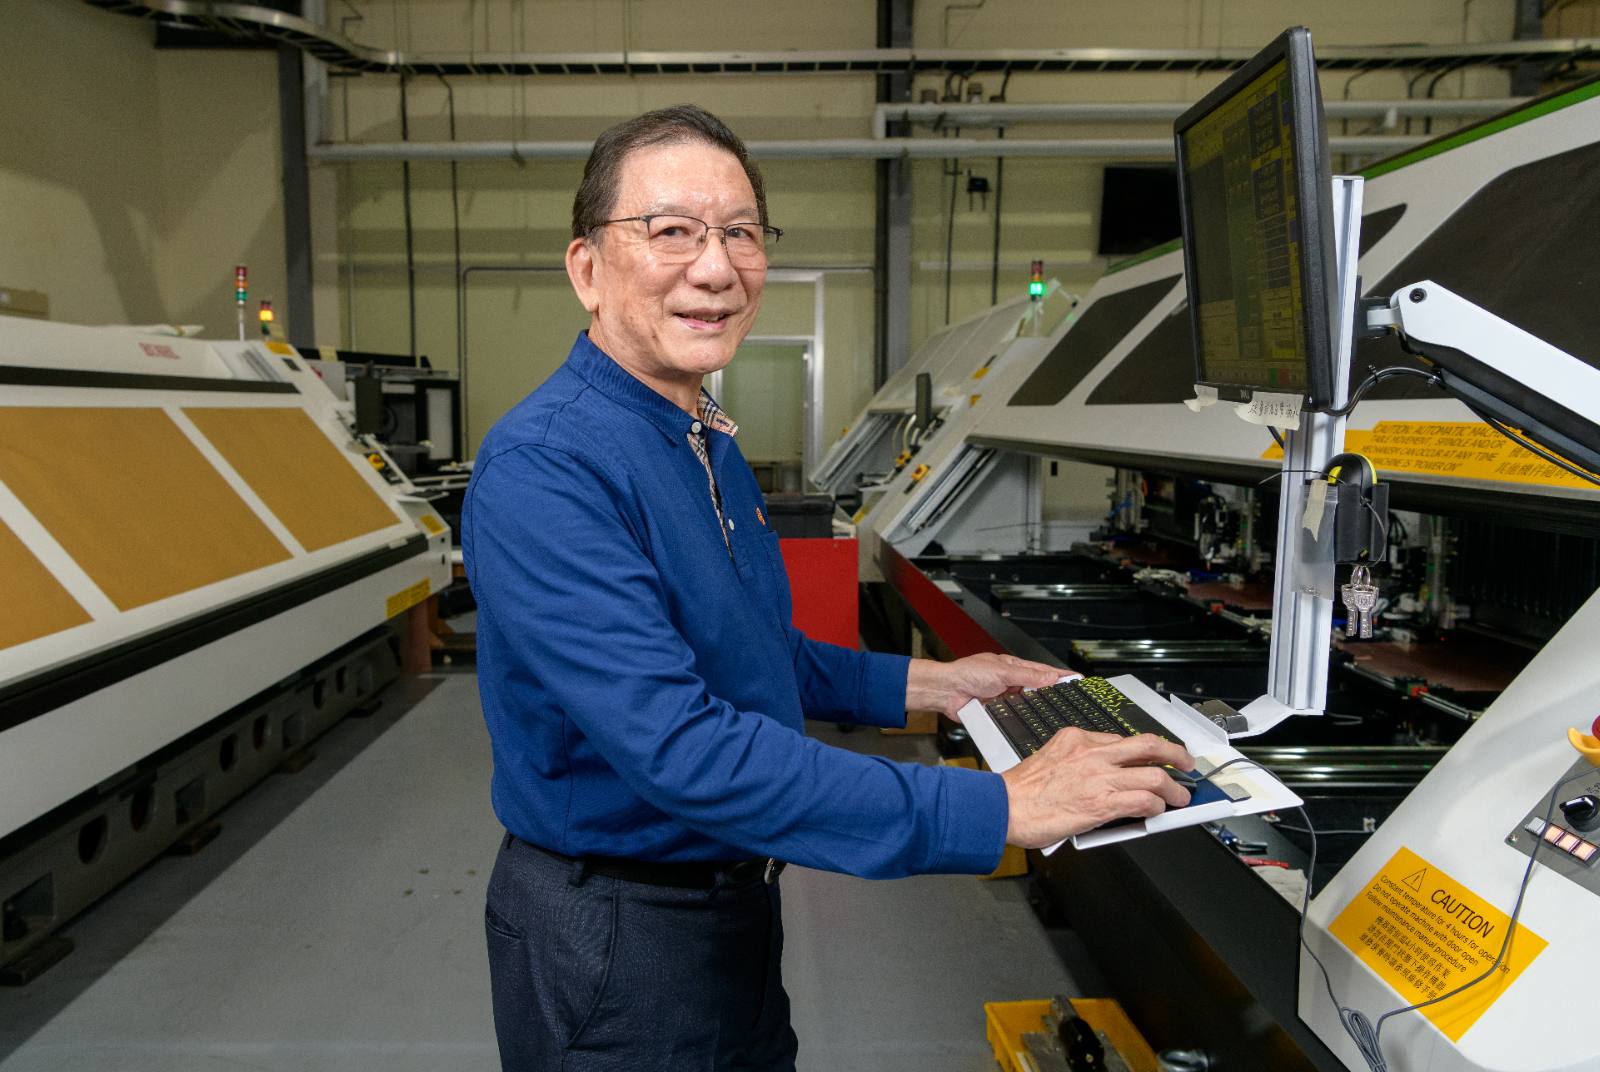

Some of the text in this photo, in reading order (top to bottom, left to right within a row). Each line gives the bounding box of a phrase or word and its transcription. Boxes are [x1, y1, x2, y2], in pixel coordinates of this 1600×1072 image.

[1373, 883, 1479, 967] Do not operate machine with door open
[1381, 875, 1404, 895] Constant
[1402, 892, 1436, 920] temperature
[1435, 916, 1446, 925] for
[1450, 926, 1468, 943] hours
[1468, 940, 1479, 950] for
[1478, 949, 1510, 974] operaion
[1382, 904, 1415, 932] maintenance
[1414, 930, 1438, 948] manual
[1434, 946, 1467, 973] procedure
[1431, 889, 1495, 938] CAUTION
